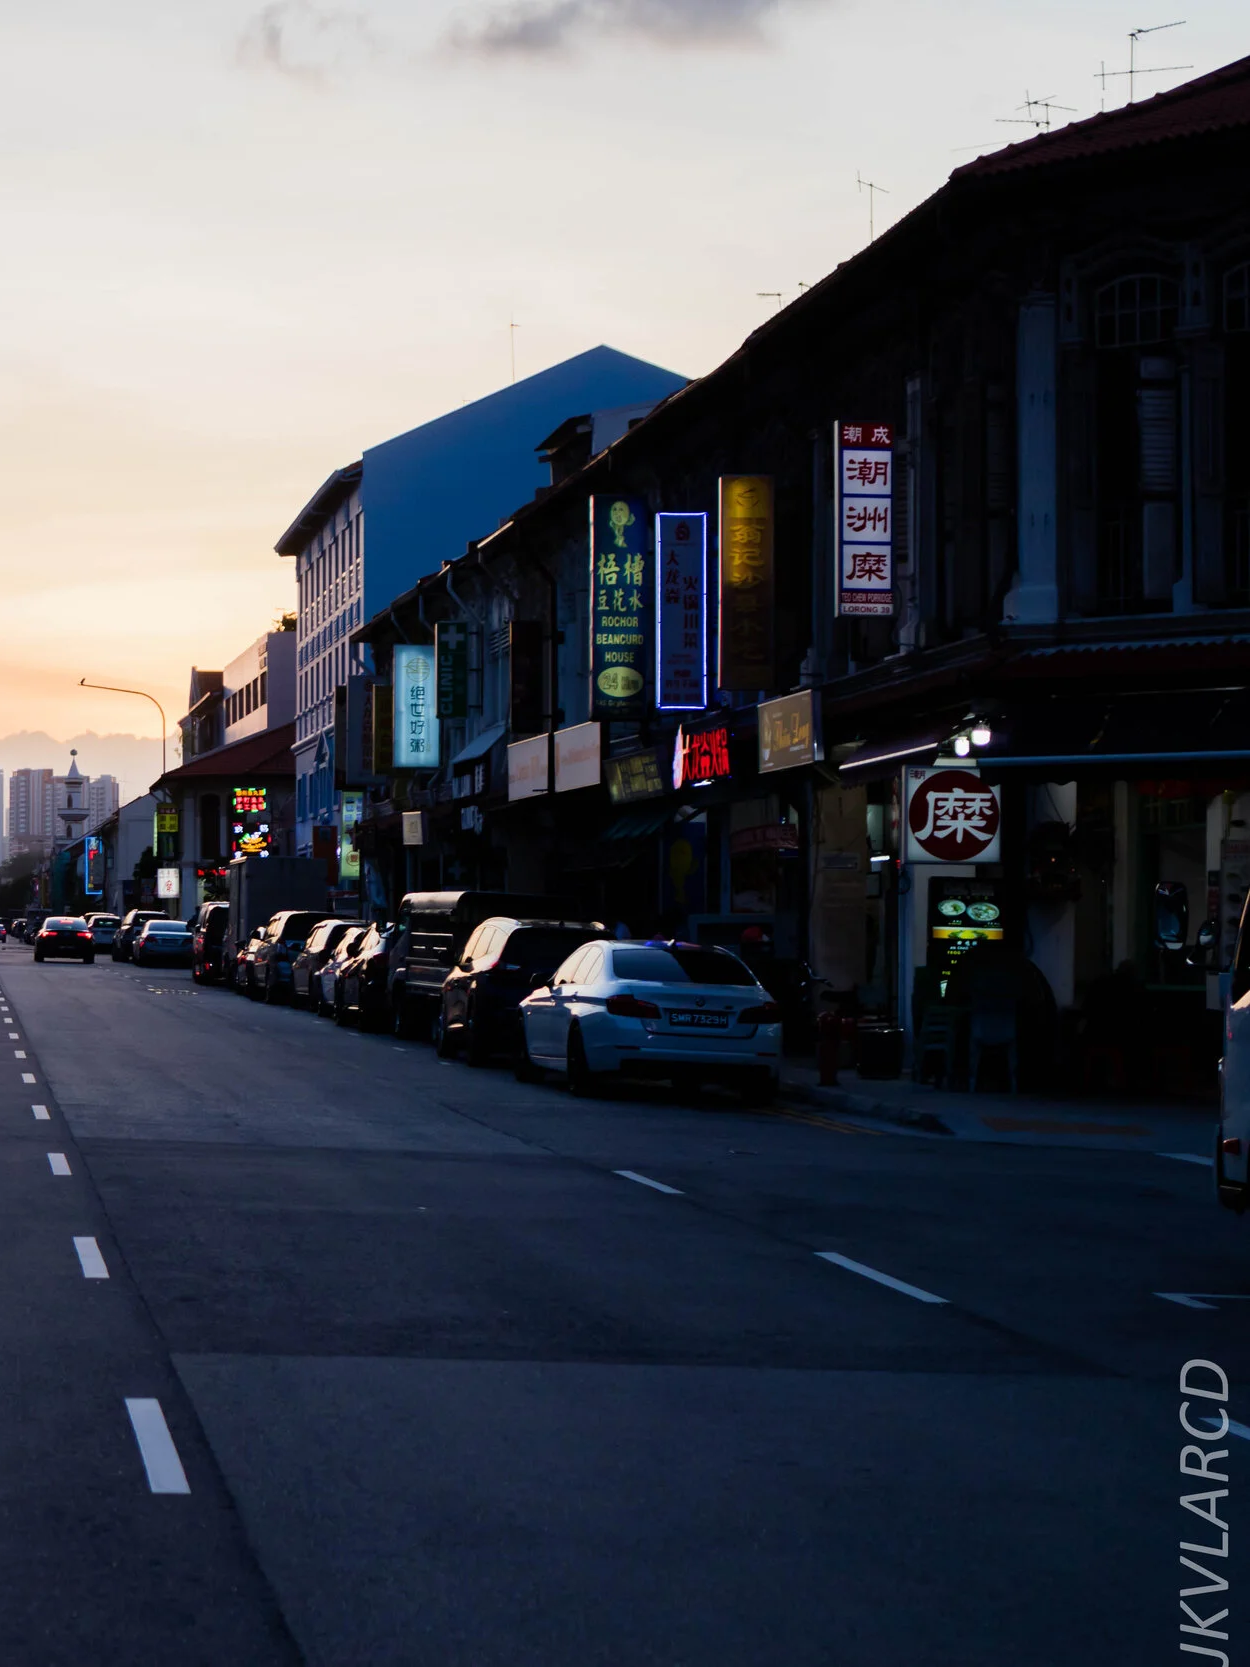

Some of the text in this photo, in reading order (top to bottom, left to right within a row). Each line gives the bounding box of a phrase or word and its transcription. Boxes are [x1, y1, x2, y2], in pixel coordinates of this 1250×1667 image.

[596, 552, 646, 587] 梧槽
[596, 588, 646, 612] 豆花水
[843, 605, 878, 613] LORONG
[601, 615, 639, 628] ROCHOR
[596, 633, 644, 646] BEANCURD
[604, 651, 635, 664] HOUSE
[439, 654, 455, 715] CLINIC
[602, 672, 619, 690] 24
[409, 685, 425, 753] 绝世好粥
[913, 787, 994, 844] 糜
